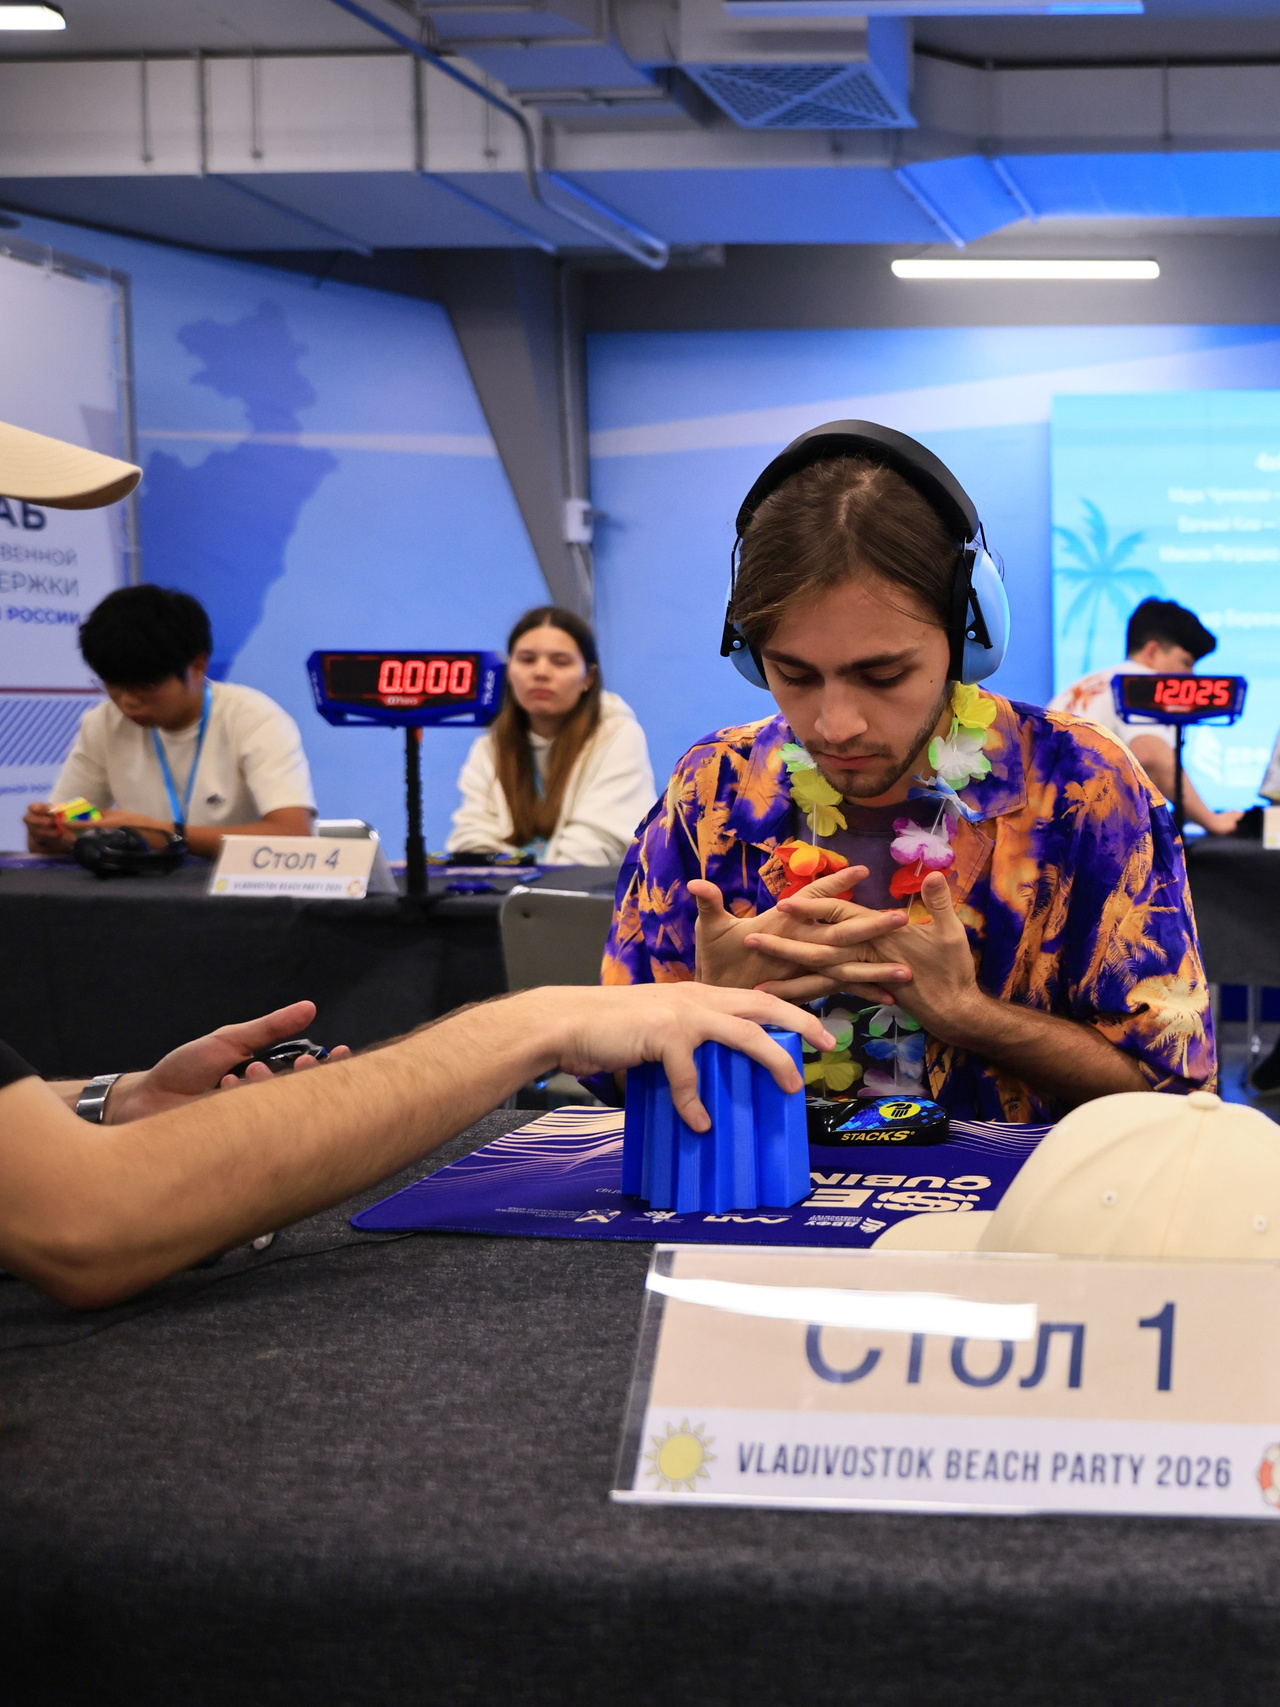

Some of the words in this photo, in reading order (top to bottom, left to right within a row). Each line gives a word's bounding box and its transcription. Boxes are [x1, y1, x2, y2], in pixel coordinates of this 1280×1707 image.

[378, 660, 473, 694] 0.000
[252, 846, 317, 869] Стол
[325, 849, 341, 869] 4
[840, 1130, 912, 1141] STACKS
[810, 1172, 992, 1190] CUBIN
[1137, 1301, 1176, 1391] 1
[737, 1442, 934, 1479] VLADIVOSTOK
[943, 1449, 1039, 1482] BEACH
[1050, 1451, 1145, 1486] PARTY
[1155, 1455, 1233, 1488] 2026
